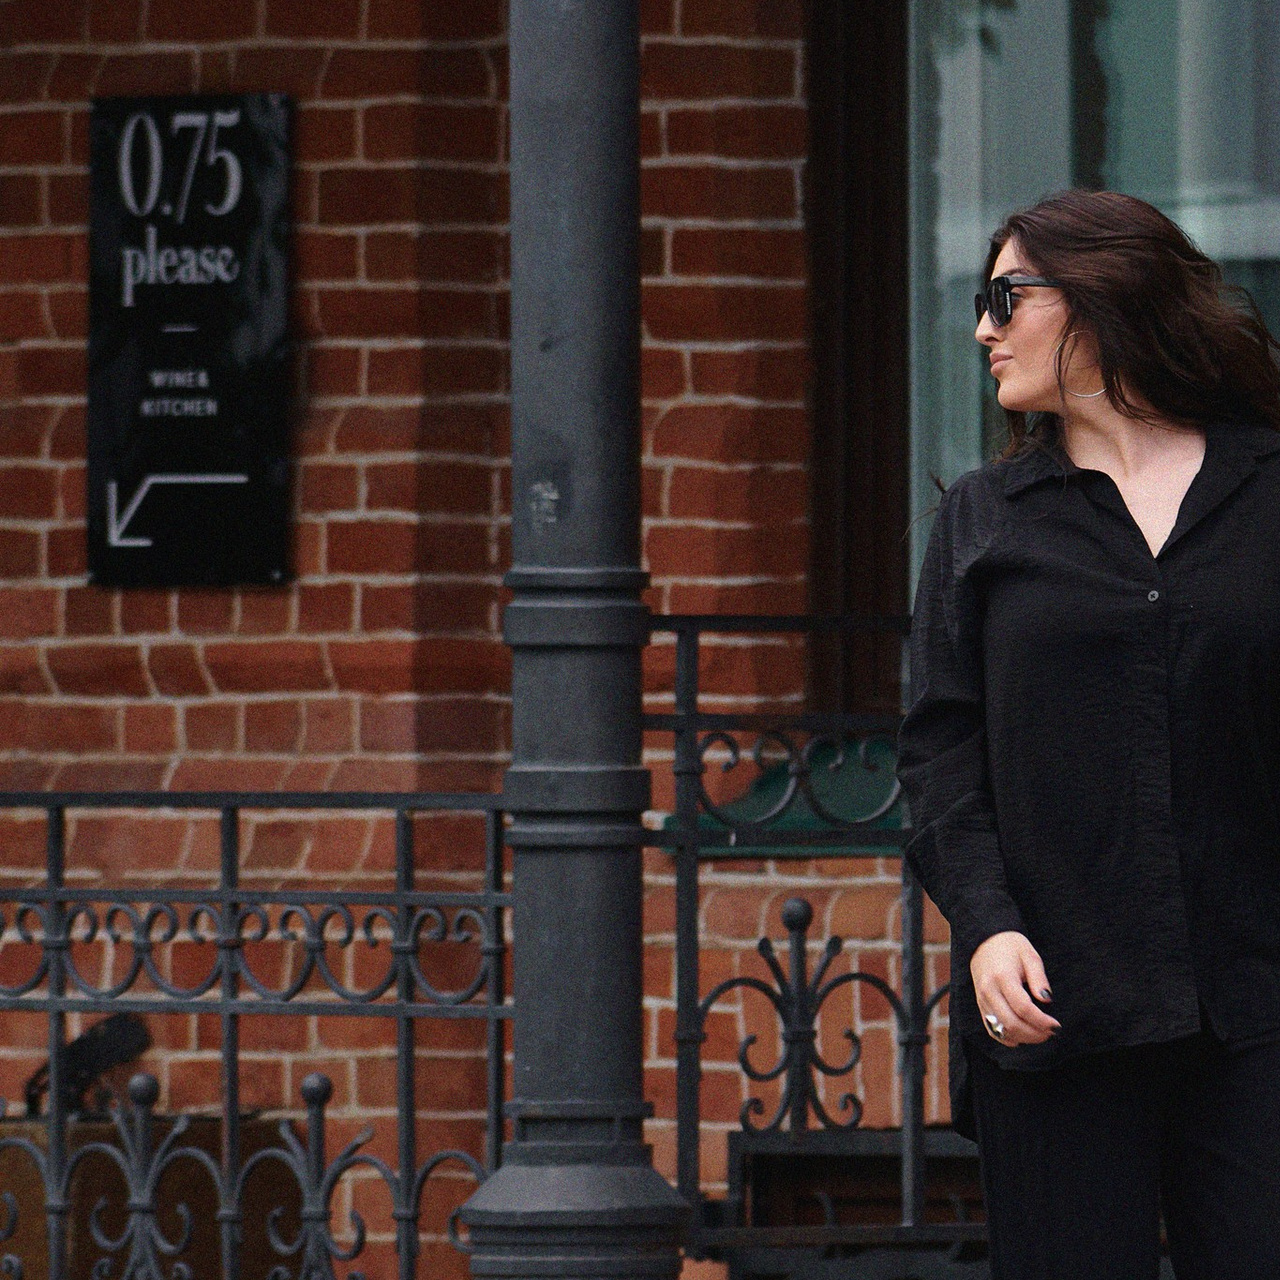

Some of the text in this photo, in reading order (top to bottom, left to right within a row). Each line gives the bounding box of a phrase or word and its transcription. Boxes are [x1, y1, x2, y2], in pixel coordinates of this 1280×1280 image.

[119, 111, 242, 223] 0.75
[122, 226, 240, 308] please
[140, 398, 218, 417] KITCHEN
